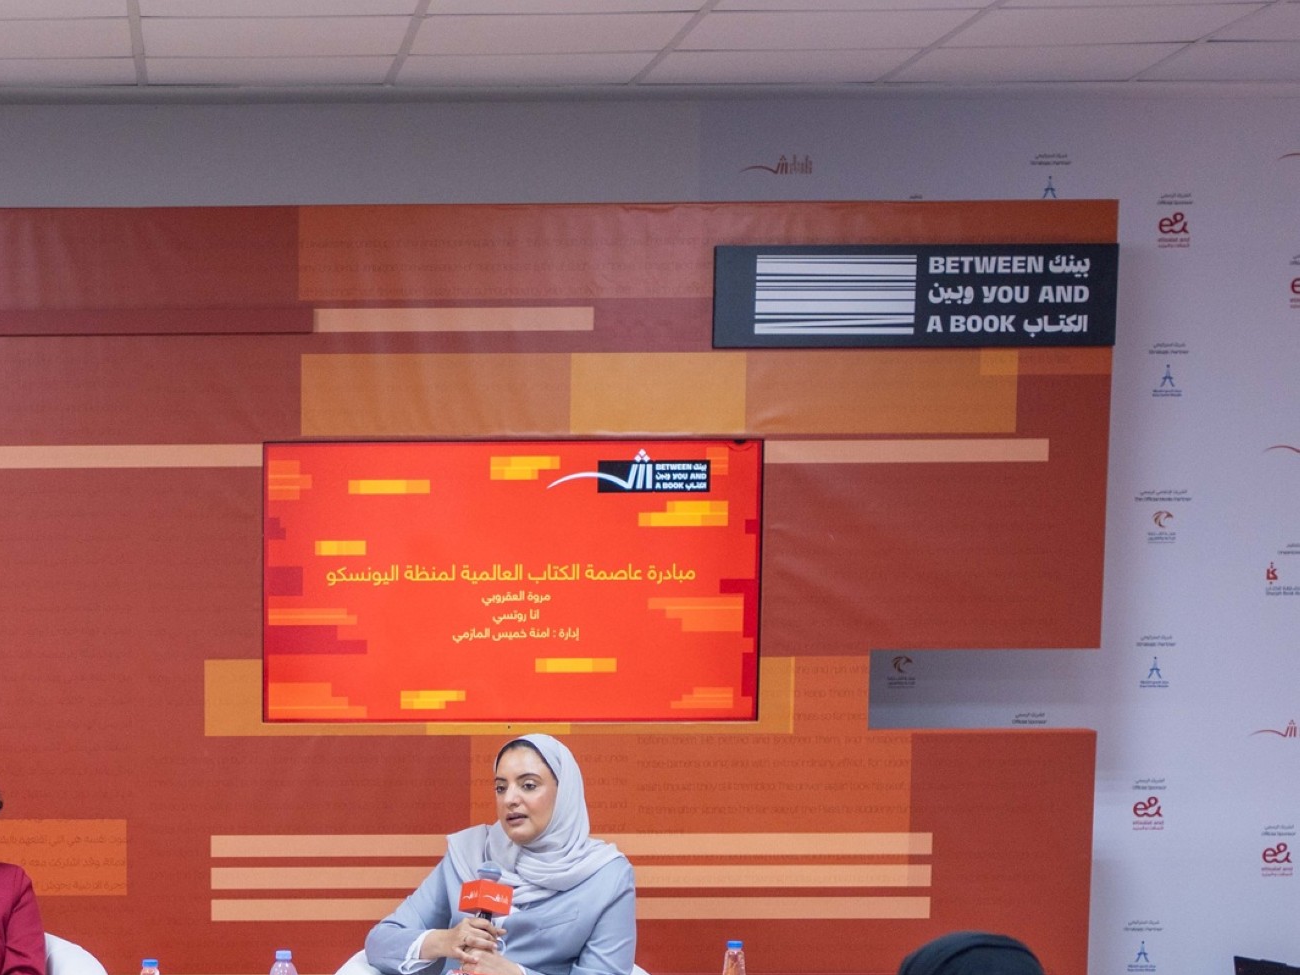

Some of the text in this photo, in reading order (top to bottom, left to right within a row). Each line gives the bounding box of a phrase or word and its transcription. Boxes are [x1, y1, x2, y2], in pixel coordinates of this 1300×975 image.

[928, 255, 1044, 274] BETWEEN
[1048, 254, 1091, 278] بينك
[928, 282, 974, 305] وبين
[982, 285, 1090, 304] YOU AND
[926, 314, 1016, 333] A BOOK
[1023, 314, 1088, 338] الكتاب
[655, 463, 692, 471] BETWEEN
[326, 564, 399, 586] اليونسكو
[460, 563, 523, 585] العالمية
[527, 563, 580, 585] الكتاب
[584, 563, 643, 581] عاصمة
[647, 563, 696, 585] مبادرة
